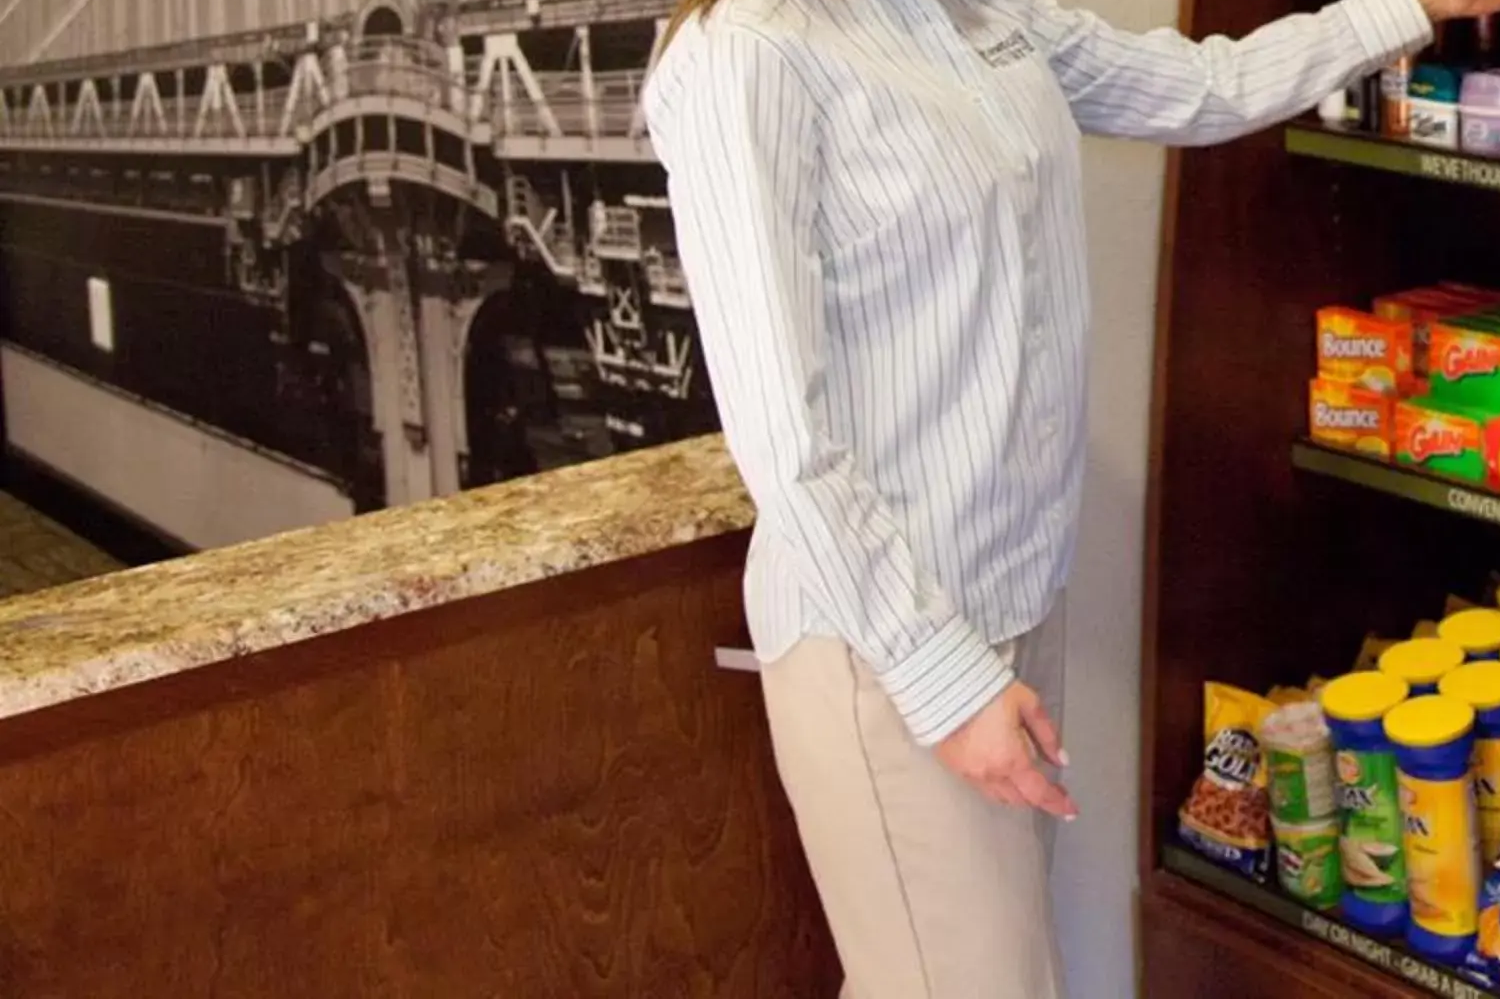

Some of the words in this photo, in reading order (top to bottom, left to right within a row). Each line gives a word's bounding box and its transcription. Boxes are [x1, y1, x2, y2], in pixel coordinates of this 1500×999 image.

[1322, 333, 1385, 359] Bounce
[1444, 343, 1500, 380] Gain
[1316, 402, 1380, 428] Bounce
[1410, 424, 1463, 461] Gain
[1399, 954, 1440, 994] GRAB
[1440, 973, 1452, 996] A
